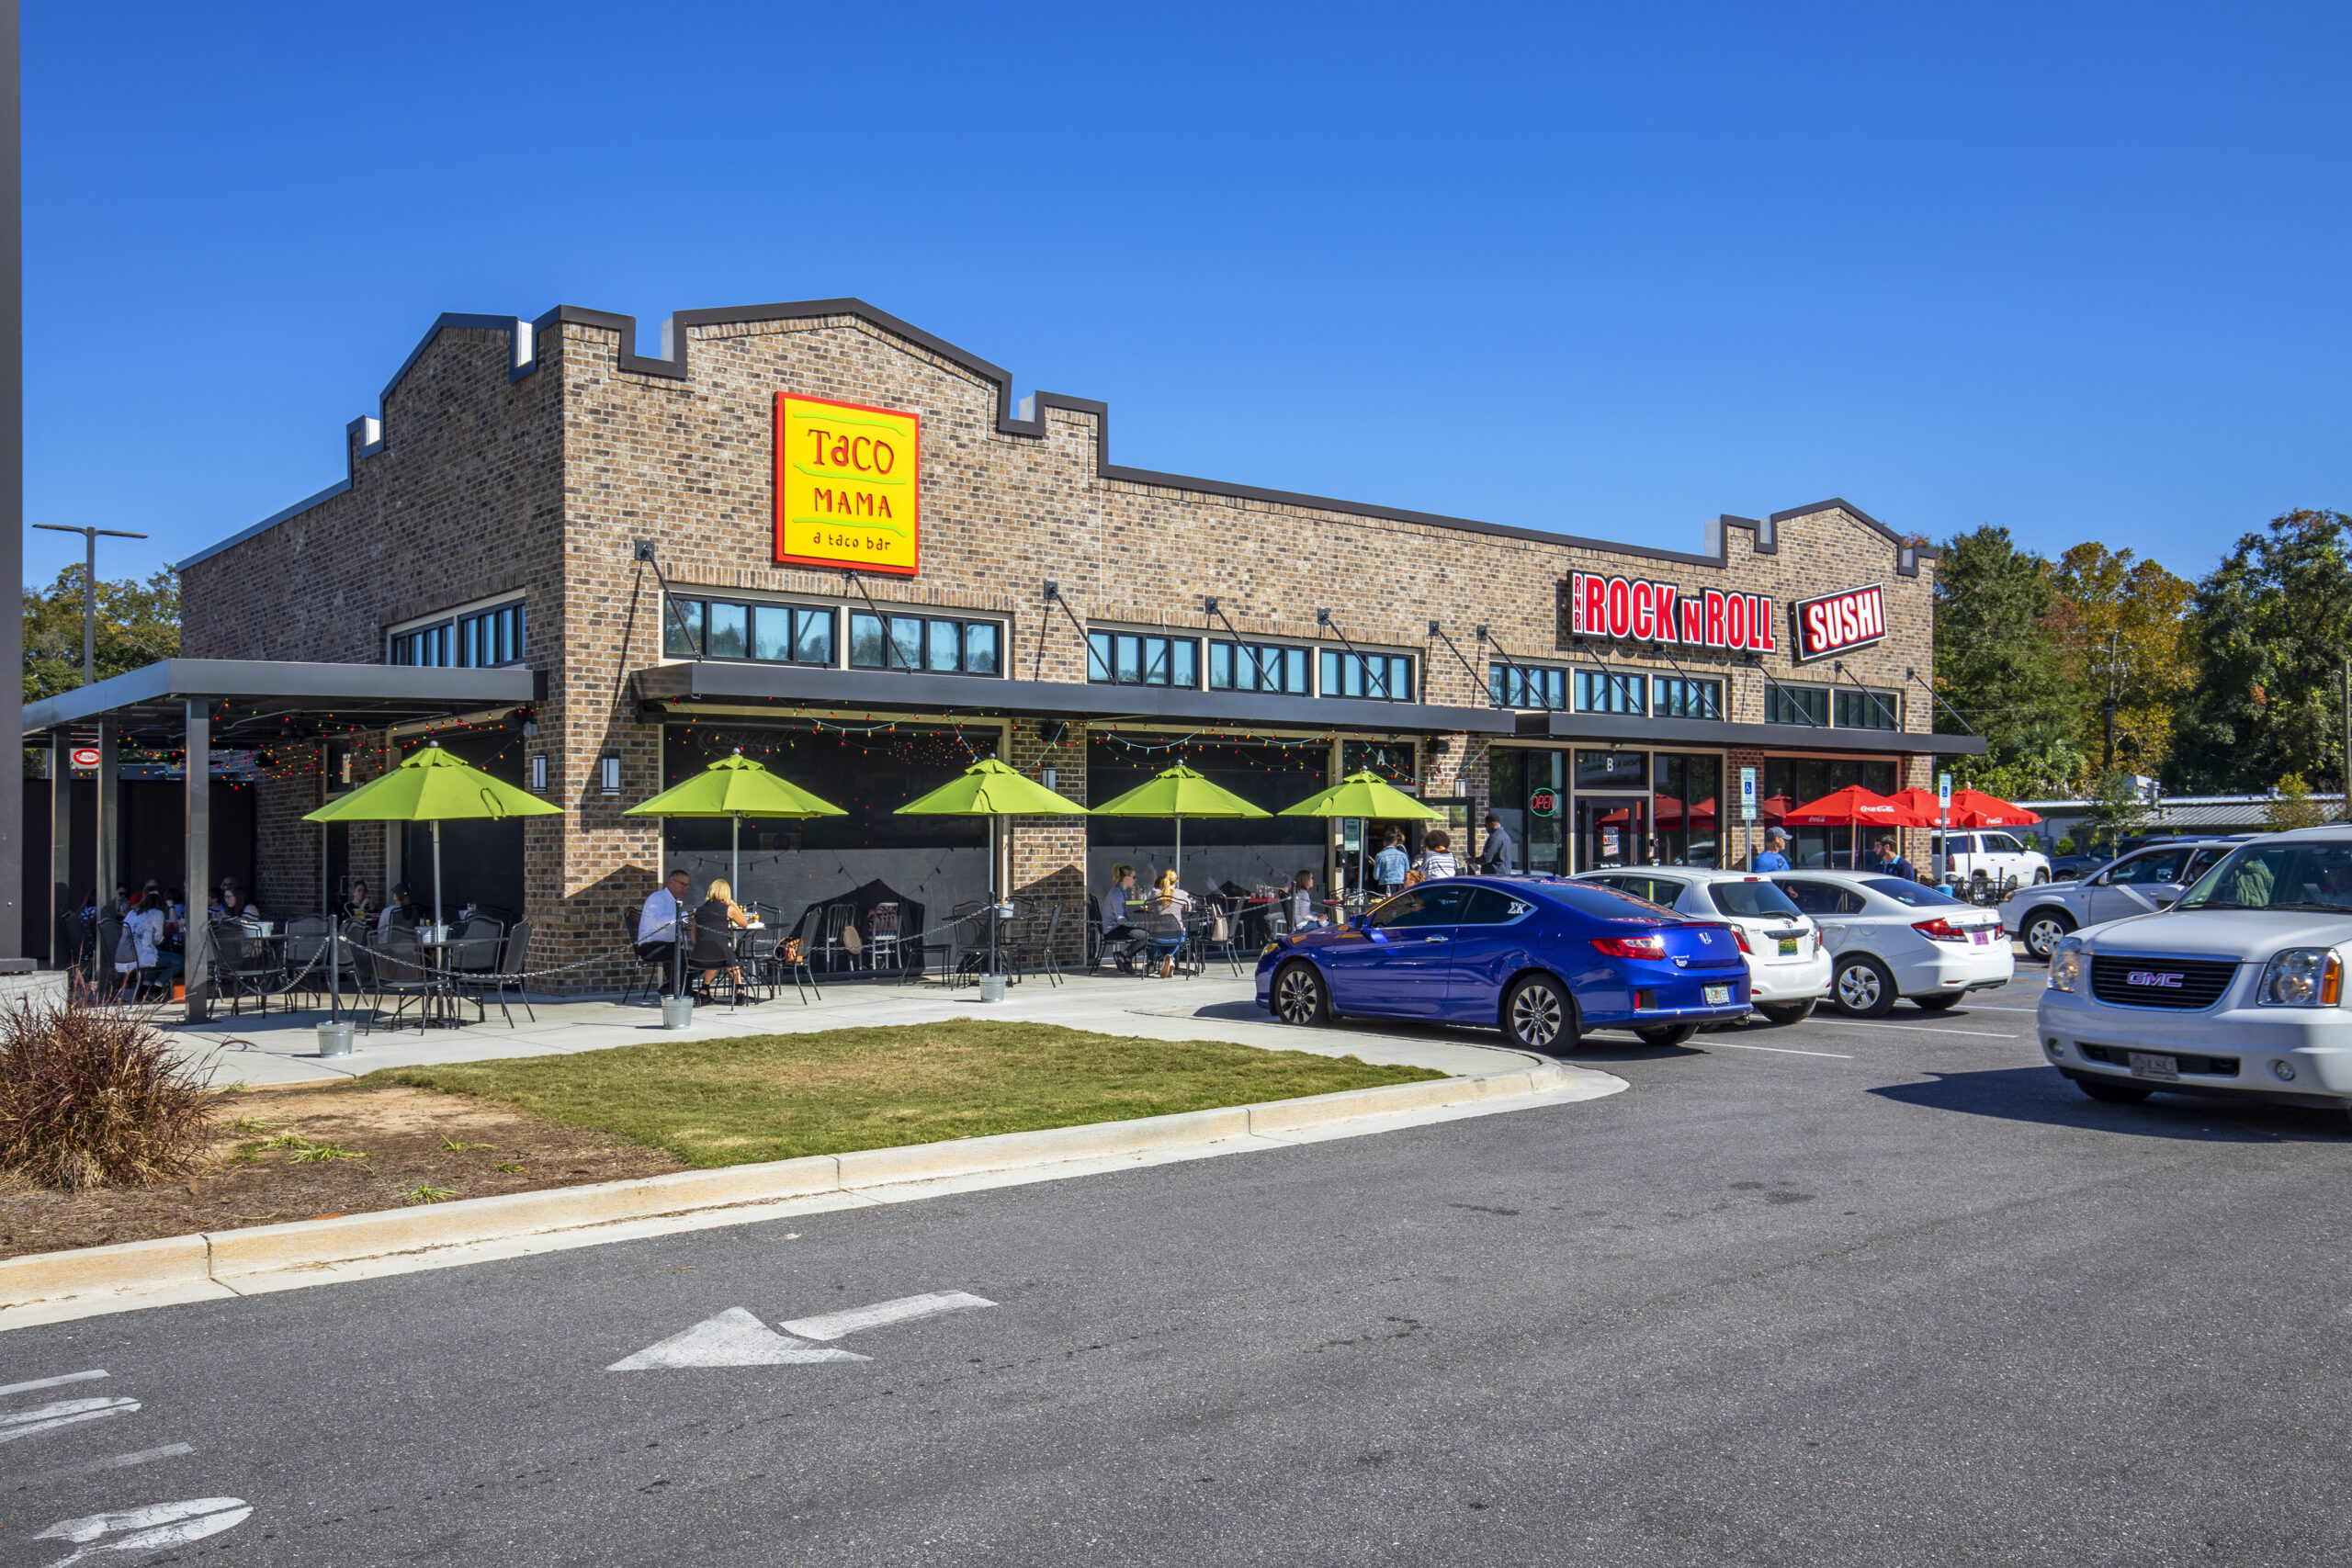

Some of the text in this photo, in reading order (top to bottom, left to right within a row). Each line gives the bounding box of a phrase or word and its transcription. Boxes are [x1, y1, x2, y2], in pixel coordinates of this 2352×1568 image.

[814, 487, 892, 519] MAMA
[813, 532, 891, 551] a taco bar
[1583, 573, 1777, 654] ROCK N ROLL
[1805, 587, 1883, 652] SUSHI
[1376, 749, 1385, 765] A
[1607, 757, 1614, 773] B
[1531, 795, 1555, 810] OPEN
[1860, 805, 1895, 813] Coca-Cola
[2127, 971, 2185, 987] GMC
